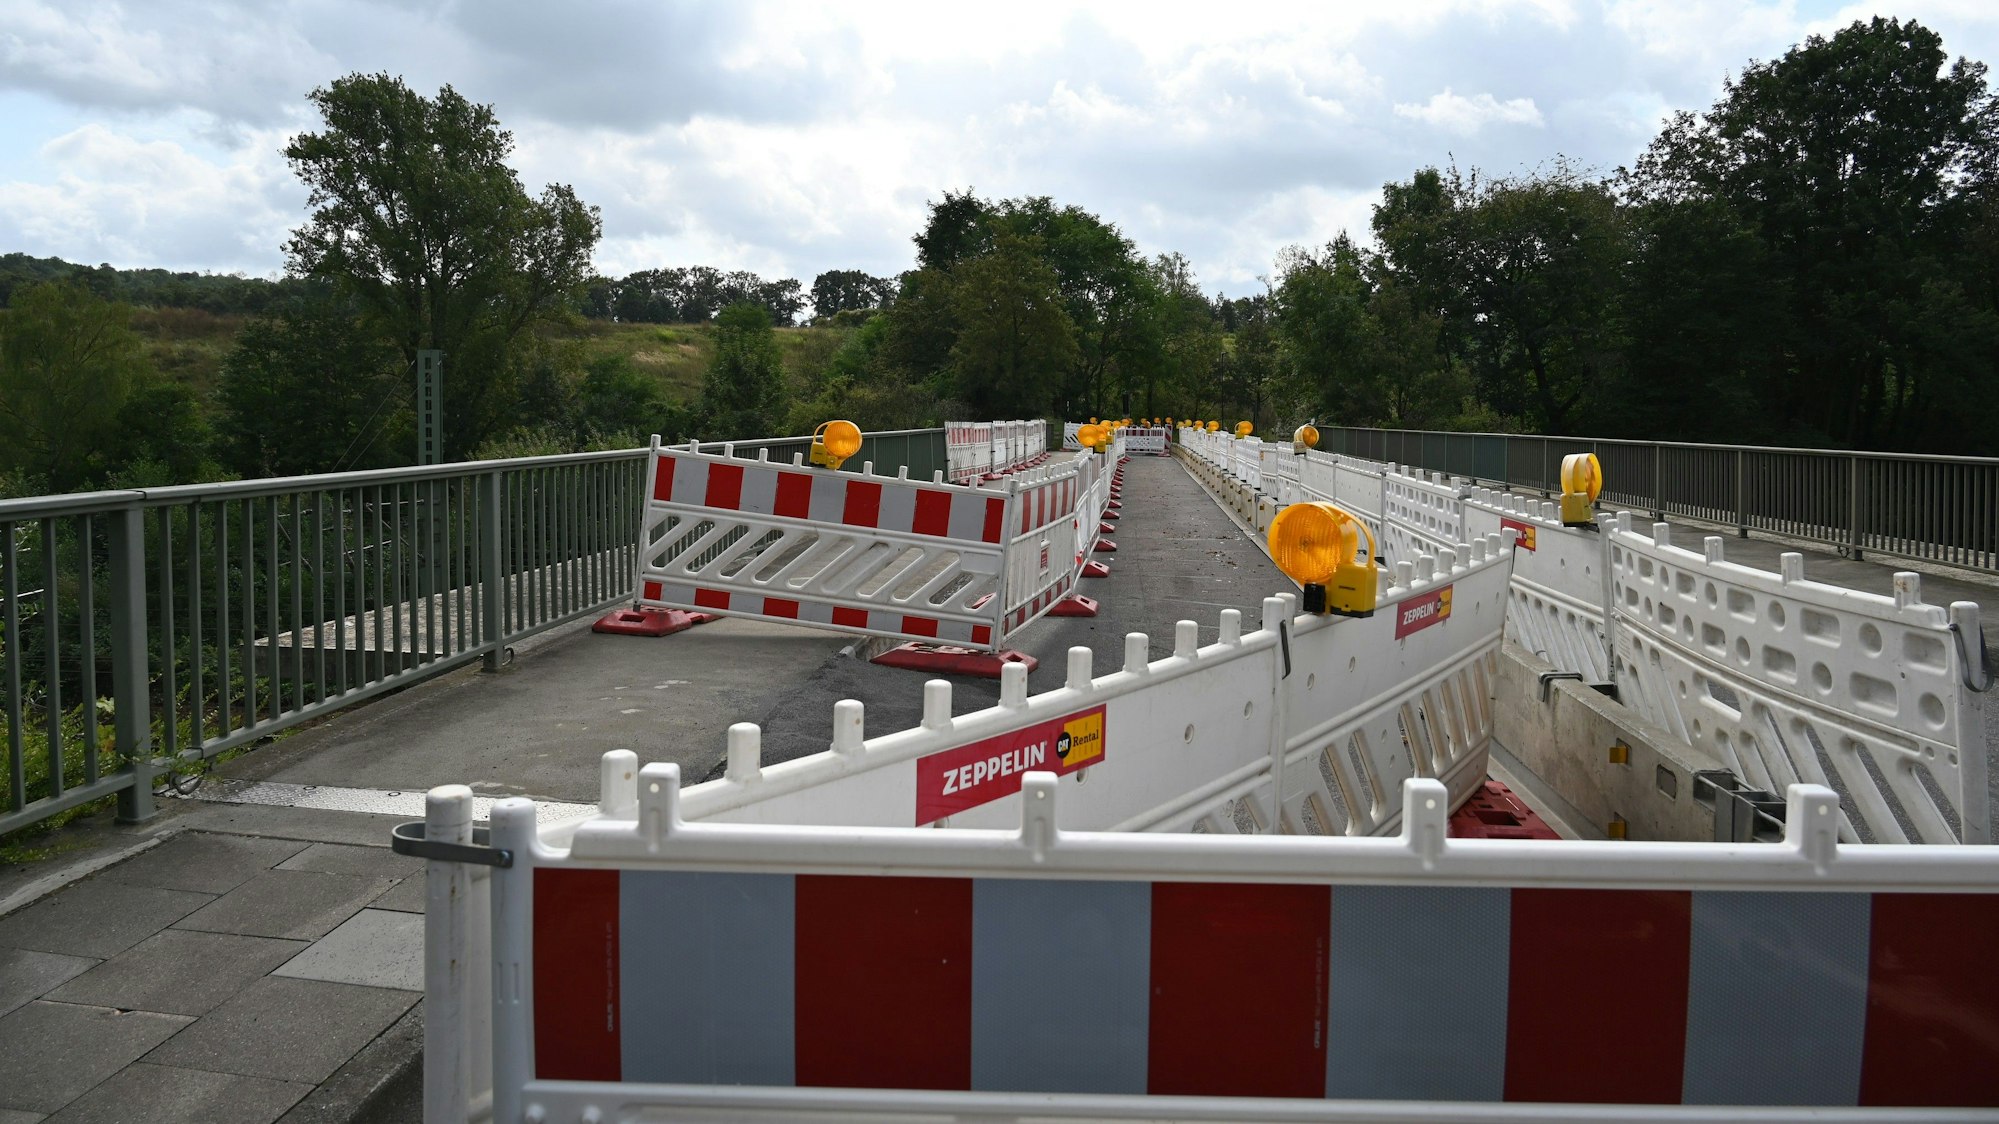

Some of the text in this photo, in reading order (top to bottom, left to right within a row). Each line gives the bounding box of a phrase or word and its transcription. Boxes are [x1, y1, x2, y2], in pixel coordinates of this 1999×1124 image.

[1402, 601, 1435, 625] ZEPPELIN
[942, 729, 1099, 796] ZEPPELIN CAT Rental
